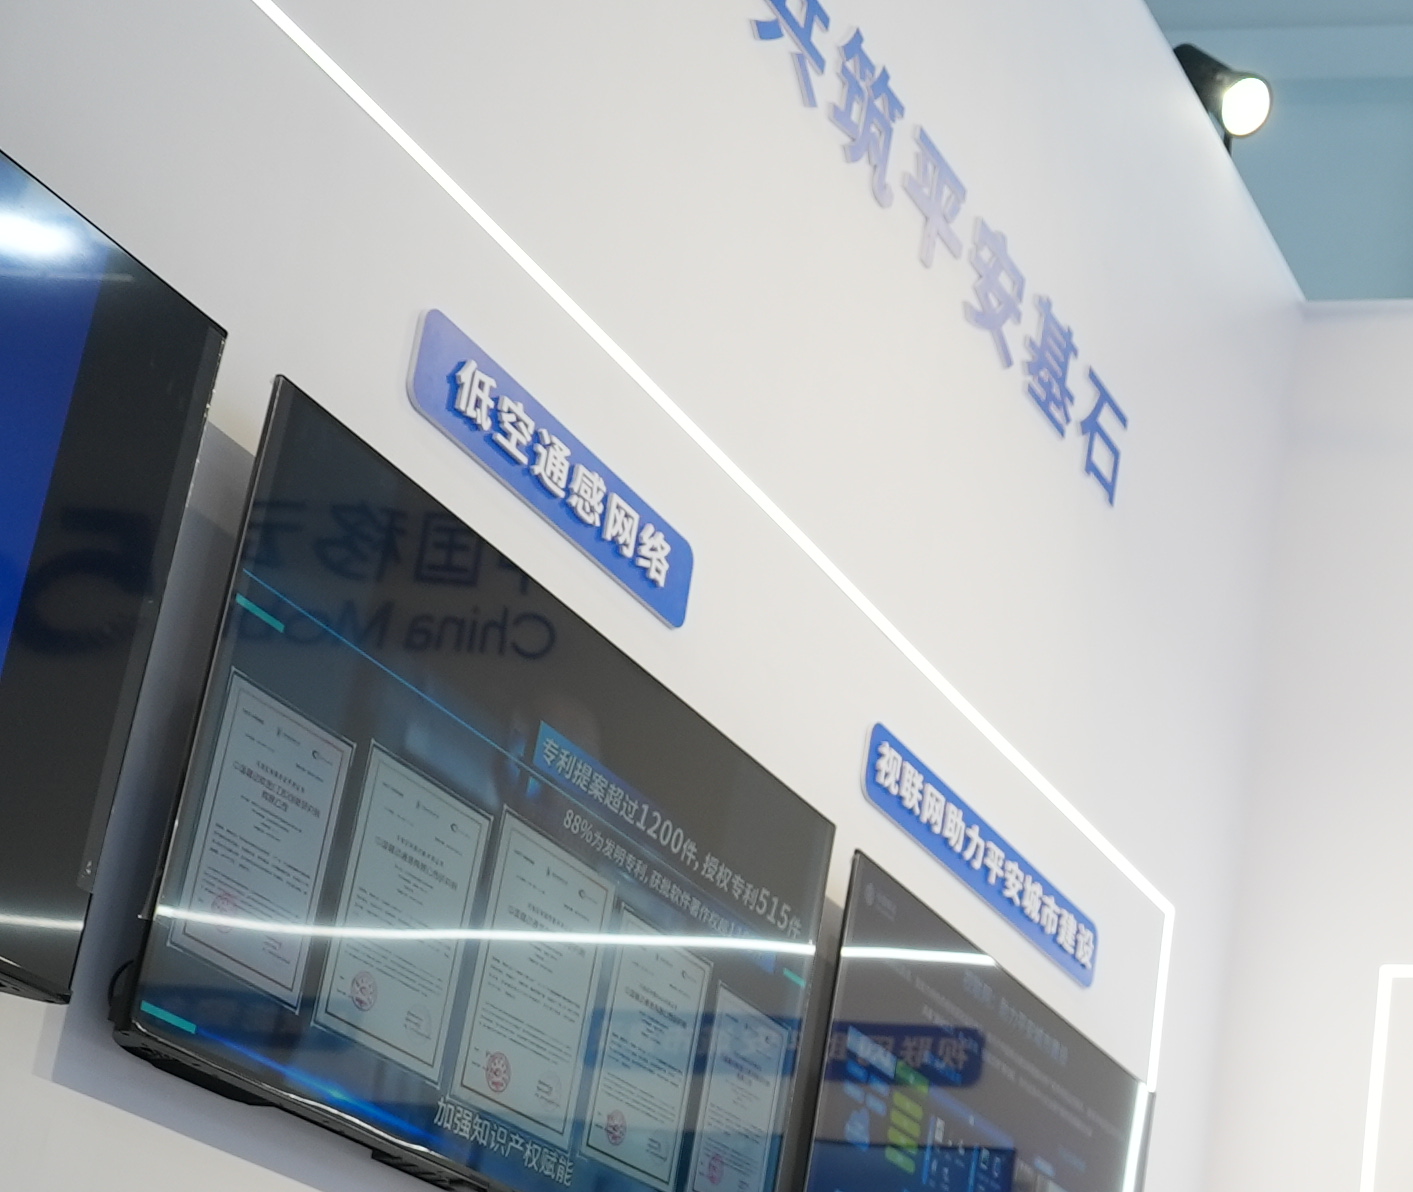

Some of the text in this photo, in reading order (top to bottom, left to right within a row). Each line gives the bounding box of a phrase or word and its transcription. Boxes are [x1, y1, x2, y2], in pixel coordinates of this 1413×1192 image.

[452, 355, 675, 590] 低空通感网络
[874, 740, 1096, 970] 视联网助力平安城市建设
[433, 1096, 574, 1188] 加强知识产权赋能
